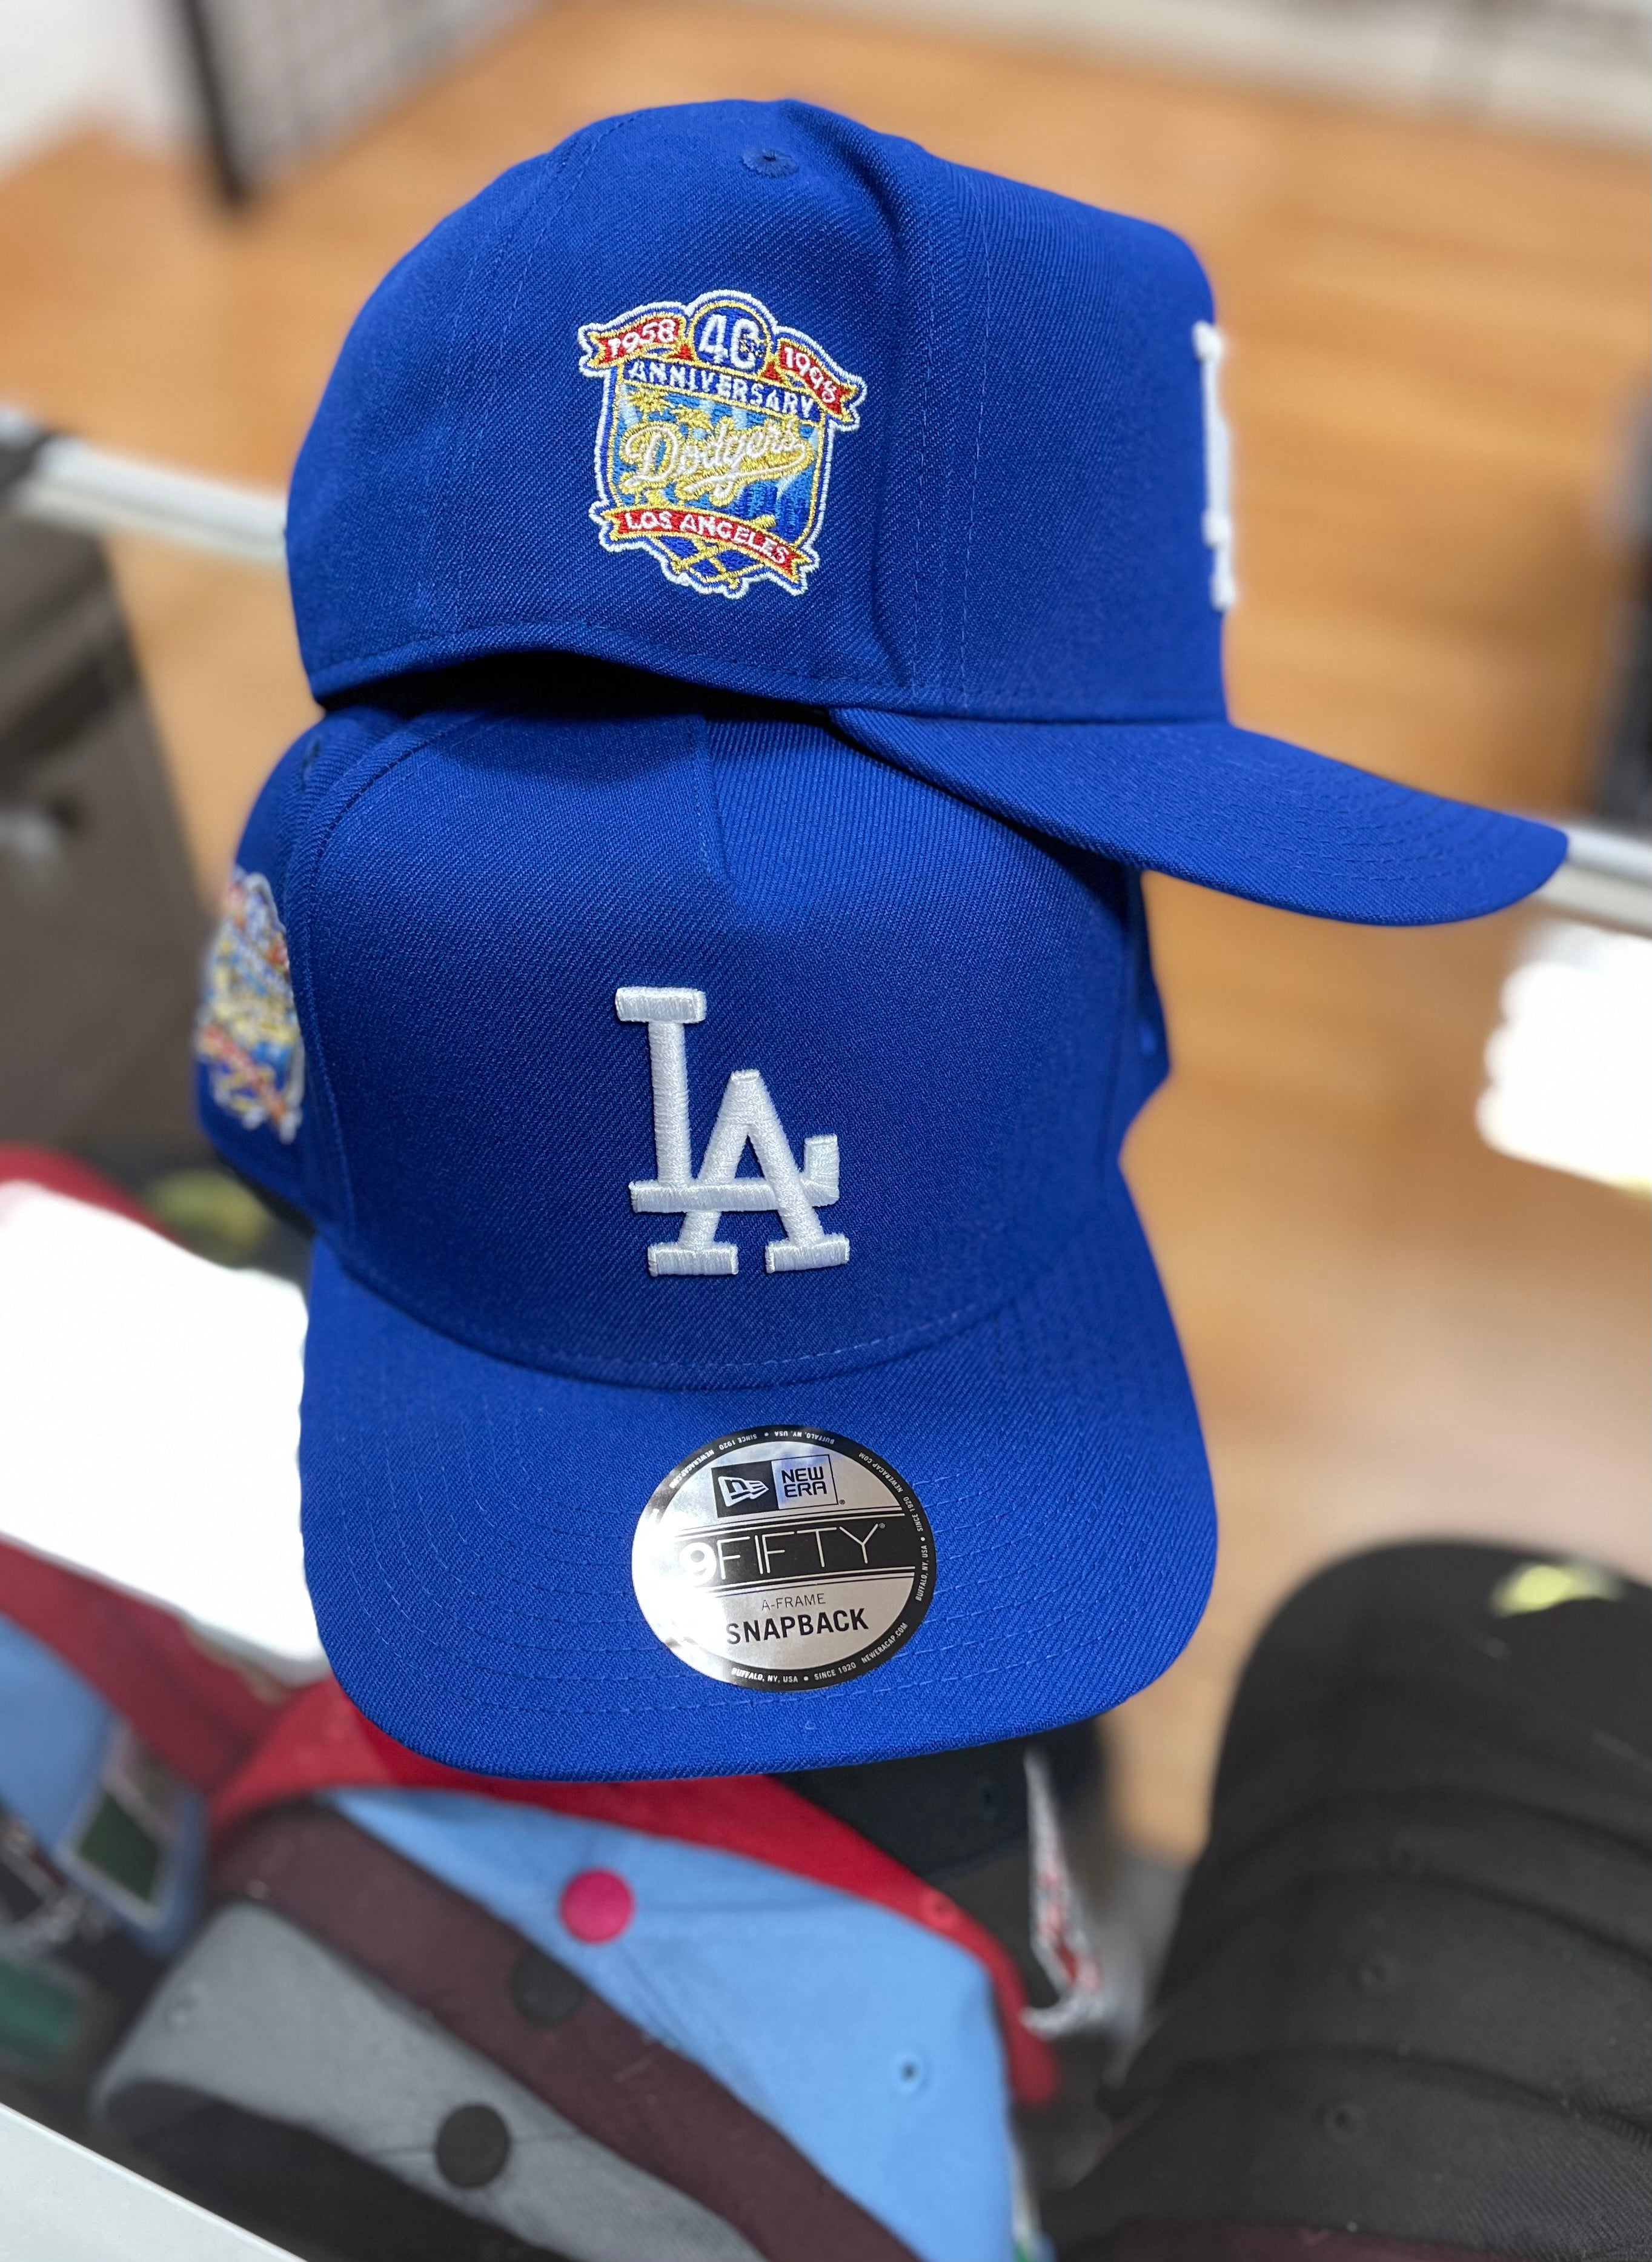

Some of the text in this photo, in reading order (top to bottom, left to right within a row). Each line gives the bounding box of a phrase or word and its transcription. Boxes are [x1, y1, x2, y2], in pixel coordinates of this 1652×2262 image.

[608, 319, 677, 358] 1958
[628, 360, 814, 419] ANNIVERSARY
[622, 416, 809, 501] Dodgers
[625, 511, 789, 563] LOS ANGELES
[615, 986, 849, 1276] LA
[718, 1439, 736, 1450] 1920
[737, 1433, 757, 1444] SINCE
[781, 1466, 824, 1484] NEW
[784, 1481, 827, 1498] ERA
[903, 1496, 915, 1511] 1920
[912, 1513, 923, 1531] SINCE
[761, 1593, 826, 1611] A-FRAME
[726, 1608, 869, 1645] SNAPBACK
[814, 1669, 836, 1680] SINCE
[838, 1662, 856, 1674] 1920
[861, 1622, 908, 1664] NEWERACAP.COM
